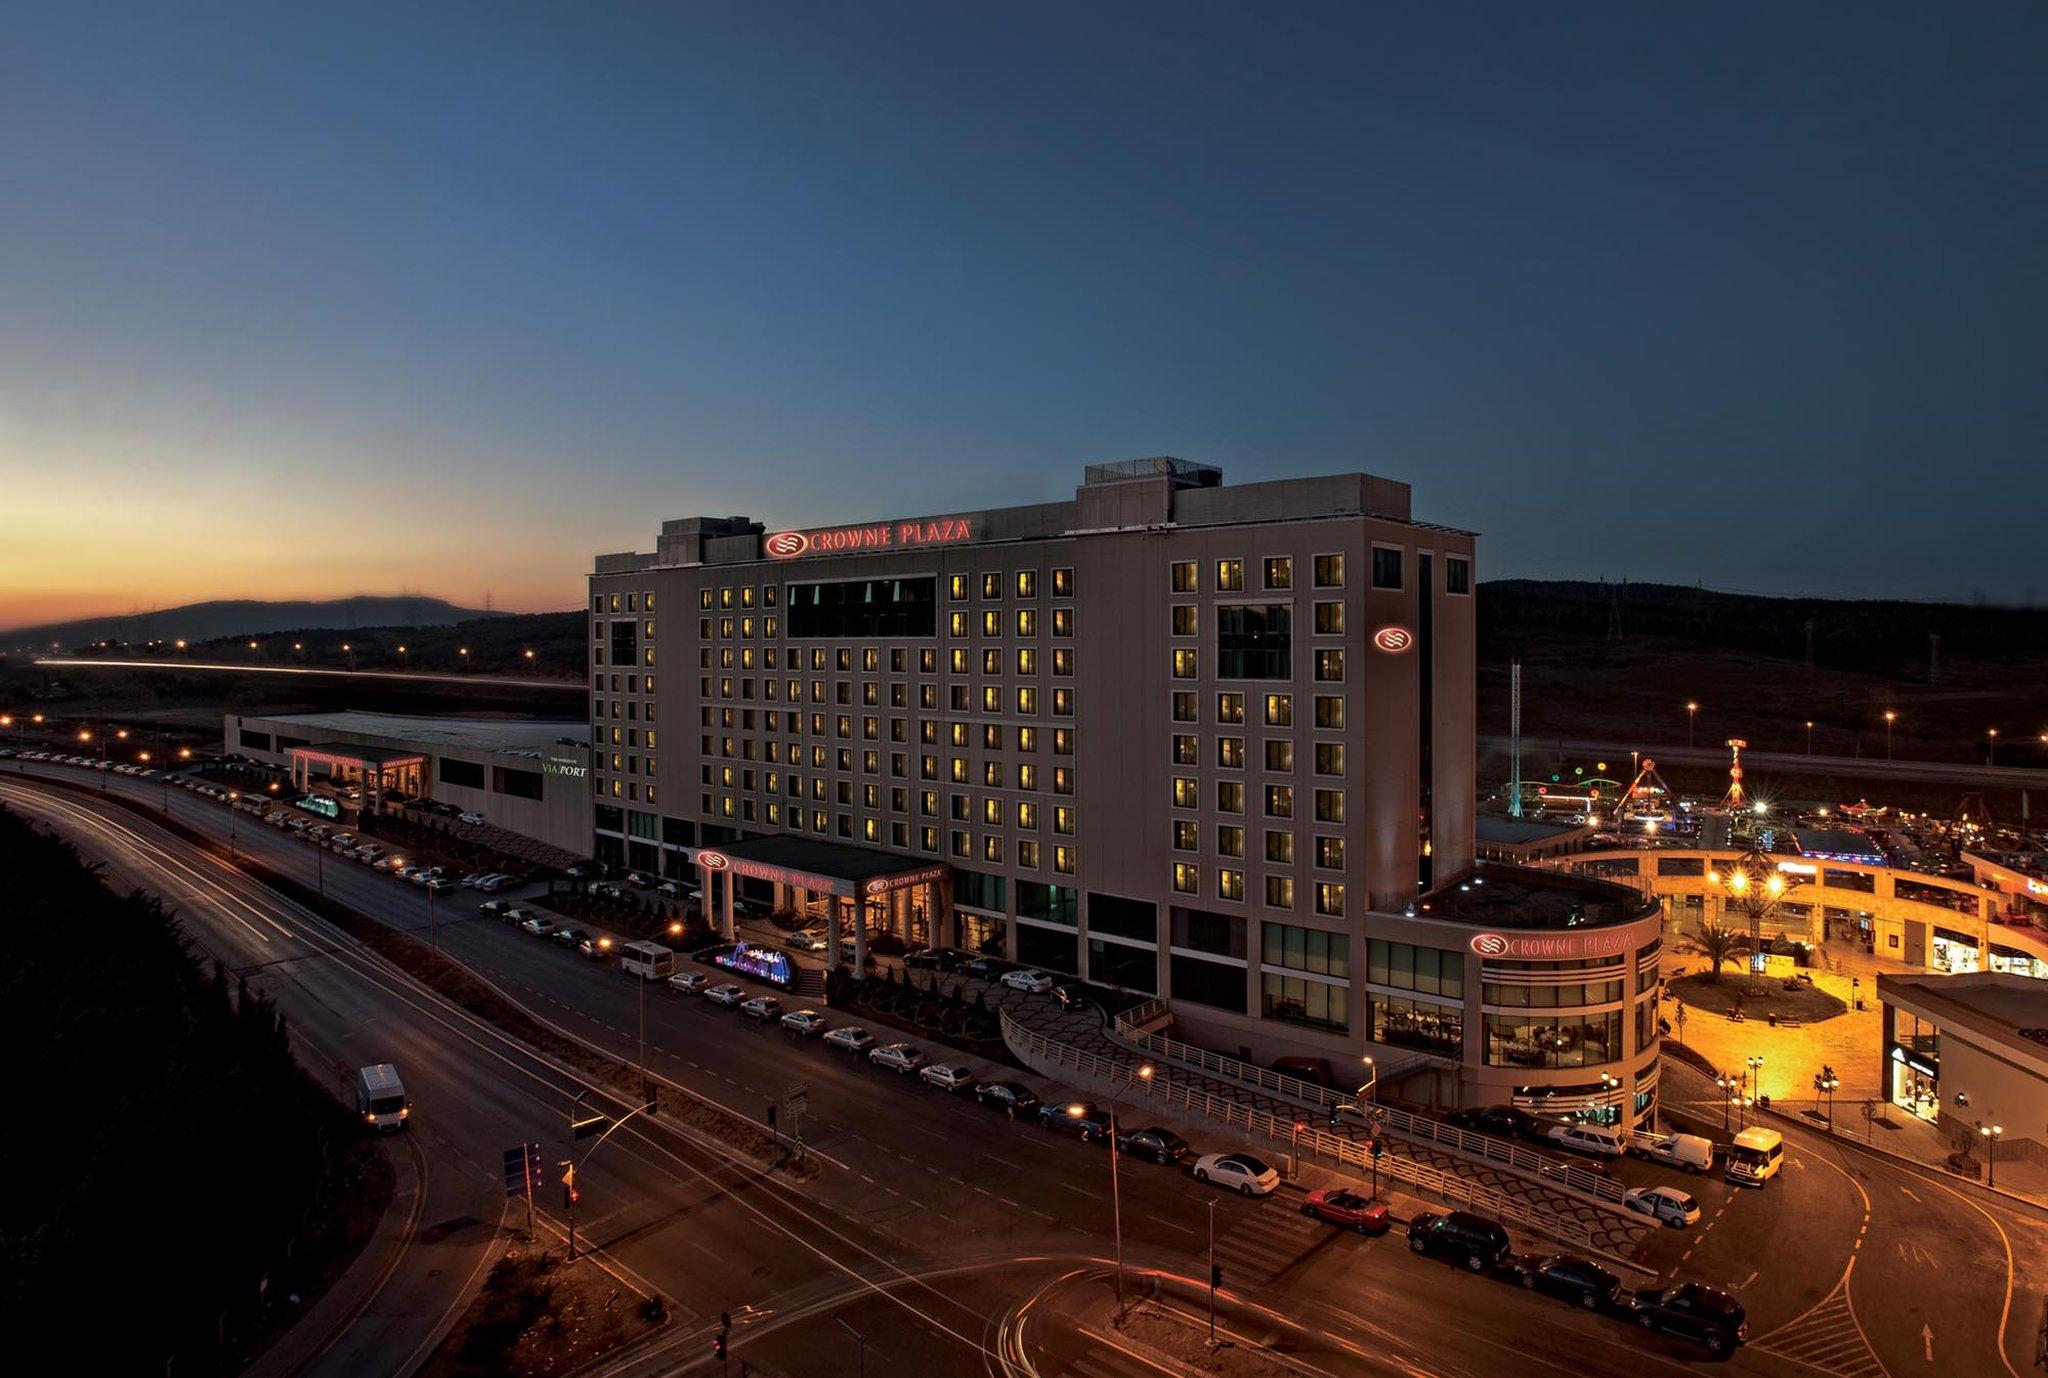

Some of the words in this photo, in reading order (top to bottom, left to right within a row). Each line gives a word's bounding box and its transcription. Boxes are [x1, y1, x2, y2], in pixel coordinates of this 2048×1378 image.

[810, 525, 891, 550] CROWNE
[901, 519, 971, 544] PLAZA
[733, 861, 785, 881] CROWNE
[889, 873, 920, 887] CROWNE
[921, 868, 942, 880] PLAZA
[1510, 938, 1574, 956] CROWNE
[1583, 933, 1634, 952] PLAZA
